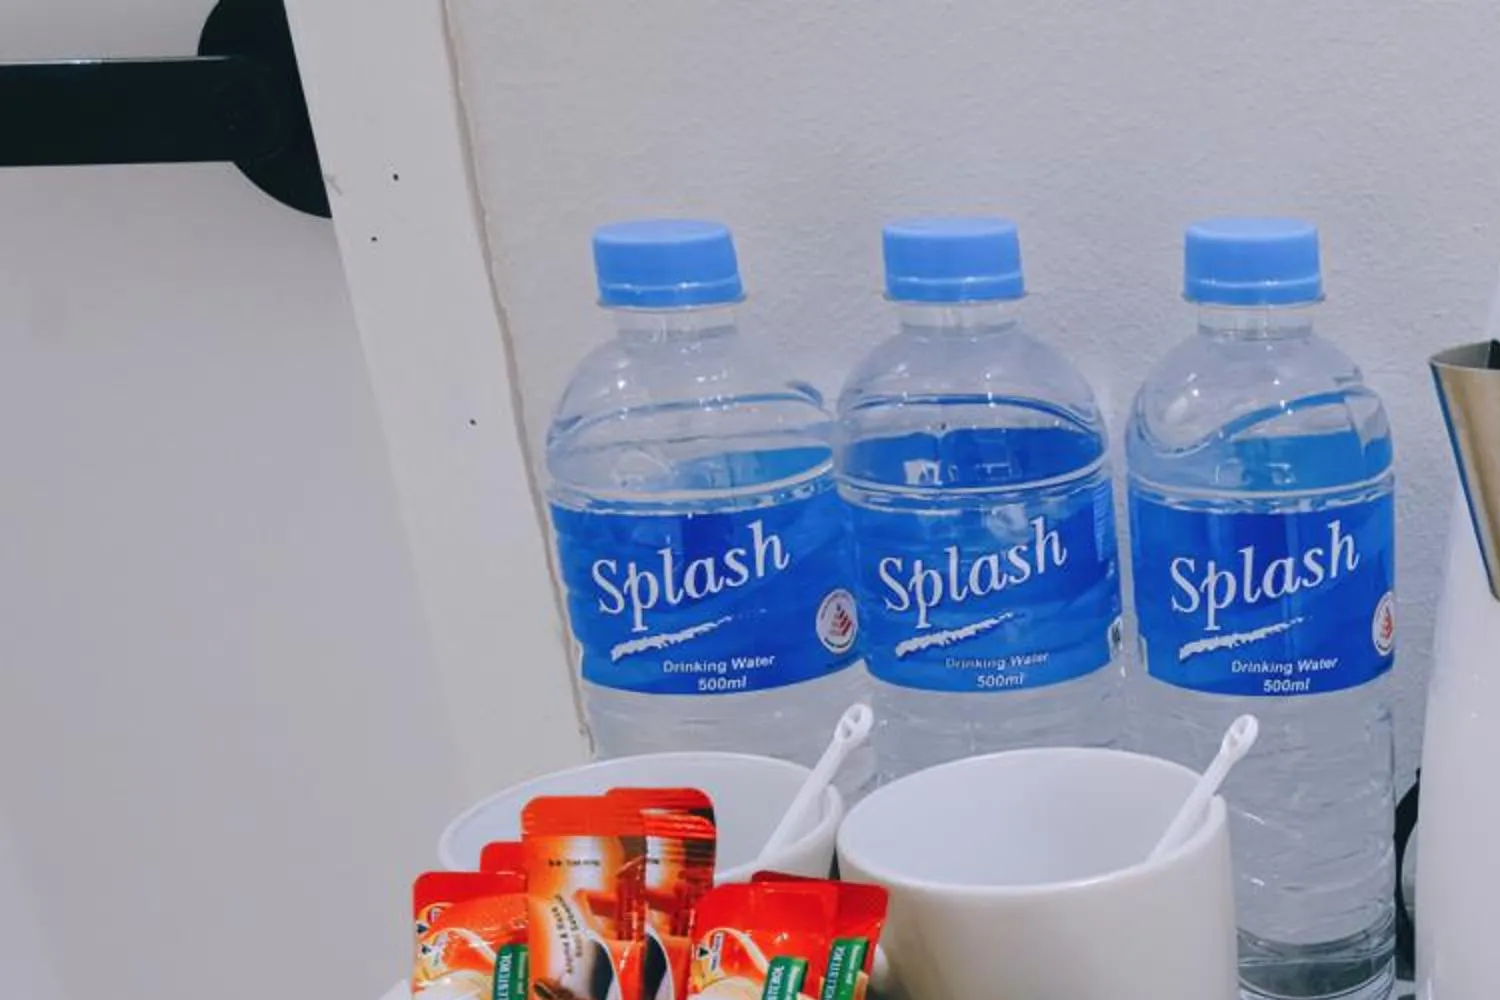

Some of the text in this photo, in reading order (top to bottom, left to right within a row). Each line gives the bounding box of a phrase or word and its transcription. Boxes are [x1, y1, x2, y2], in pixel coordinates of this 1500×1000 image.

[592, 520, 790, 632] Splash
[879, 516, 1067, 628] Splash
[1170, 520, 1360, 630] Splash
[663, 655, 776, 675] Drinking Water
[1231, 656, 1340, 675] Drinking Water
[698, 676, 748, 691] 500ml
[976, 673, 1025, 689] 500ml
[1263, 678, 1311, 693] 500ml
